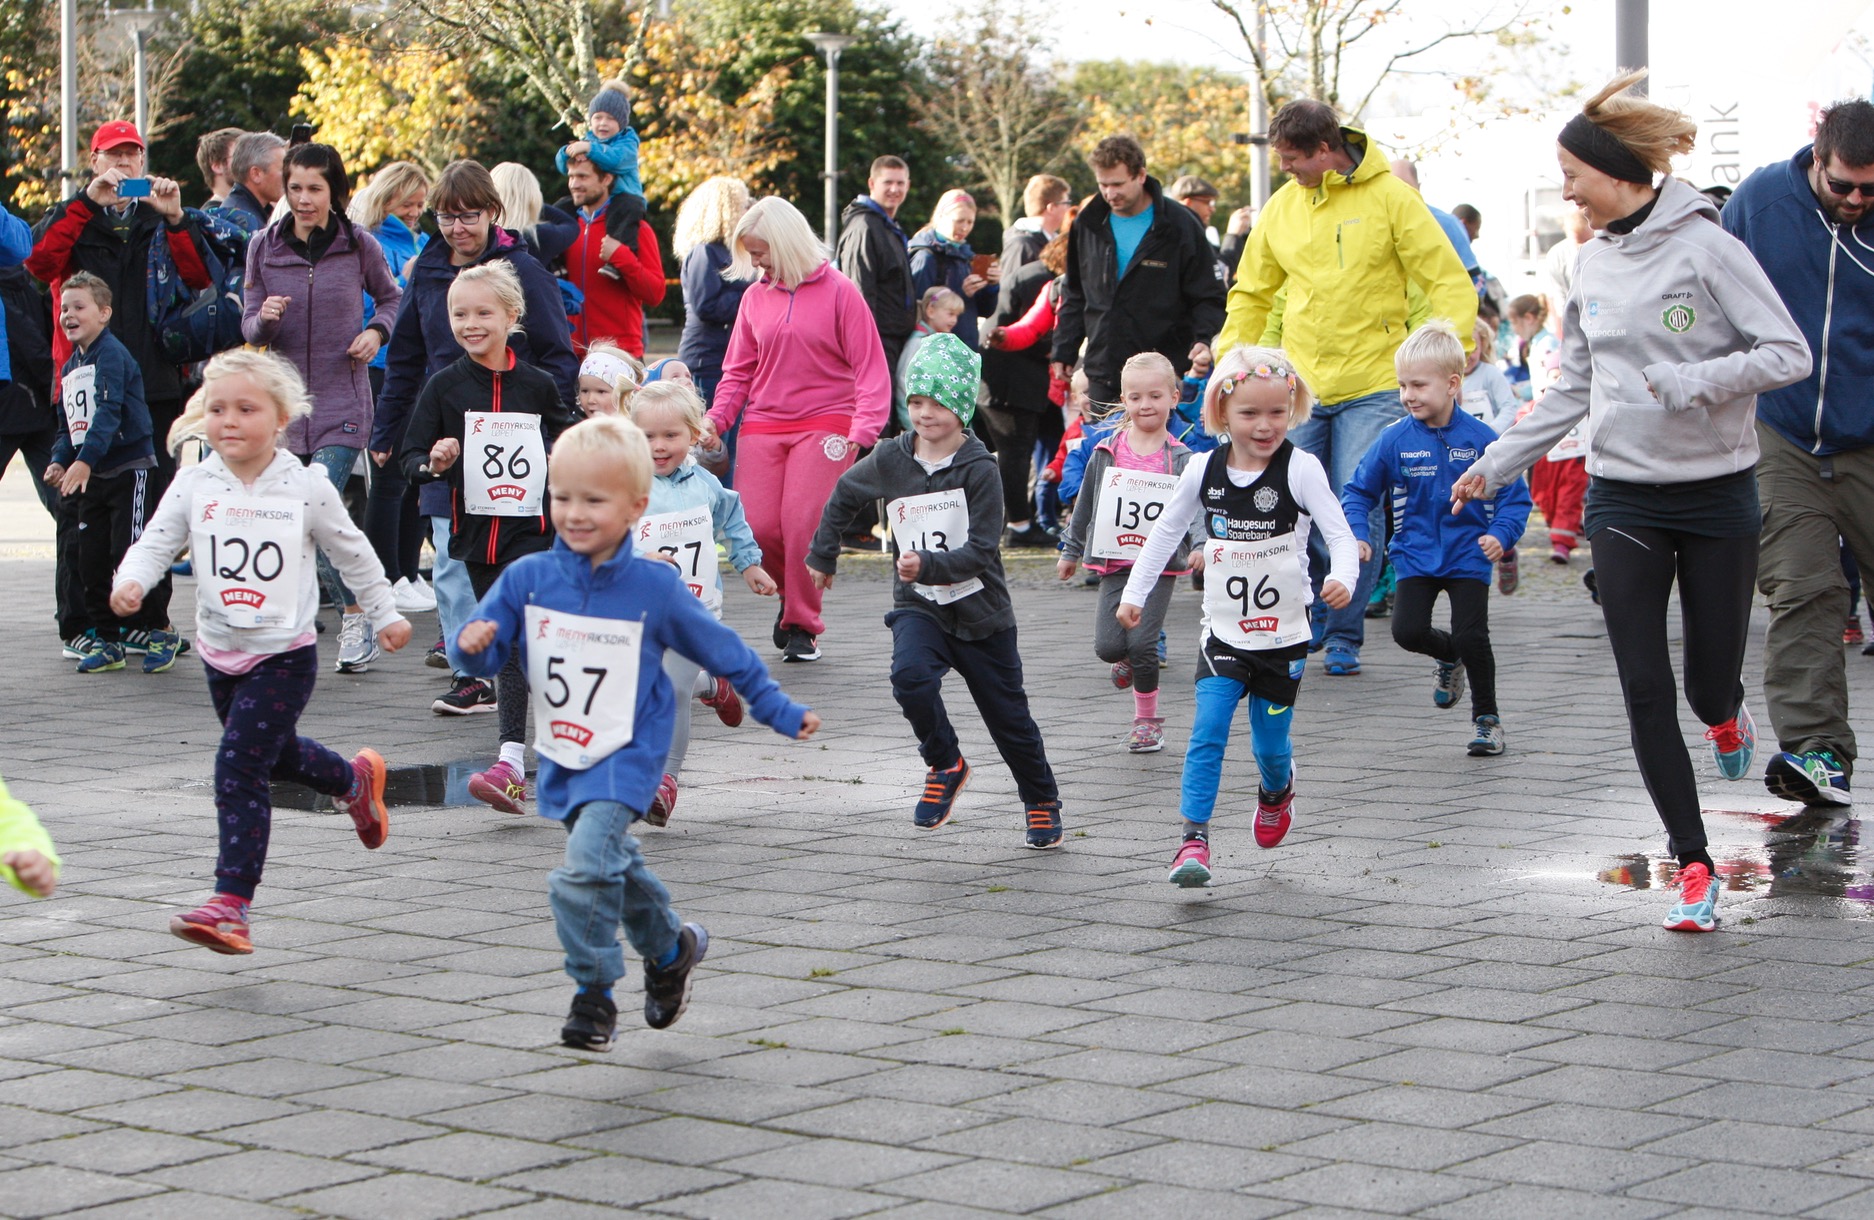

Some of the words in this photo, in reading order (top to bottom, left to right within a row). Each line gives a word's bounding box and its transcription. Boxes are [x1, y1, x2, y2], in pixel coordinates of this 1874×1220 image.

[1585, 329, 1627, 338] DEEPOCEAN
[482, 444, 531, 480] 86
[491, 487, 523, 497] MENY
[1227, 518, 1276, 530] Haugesund
[1228, 529, 1272, 540] Sparebank
[210, 534, 284, 582] 120
[1231, 560, 1257, 568] LØPET
[224, 591, 262, 604] MENY
[1226, 574, 1280, 617] 96
[1243, 619, 1276, 630] MENY
[544, 656, 607, 716] 57
[553, 723, 589, 743] MENY
